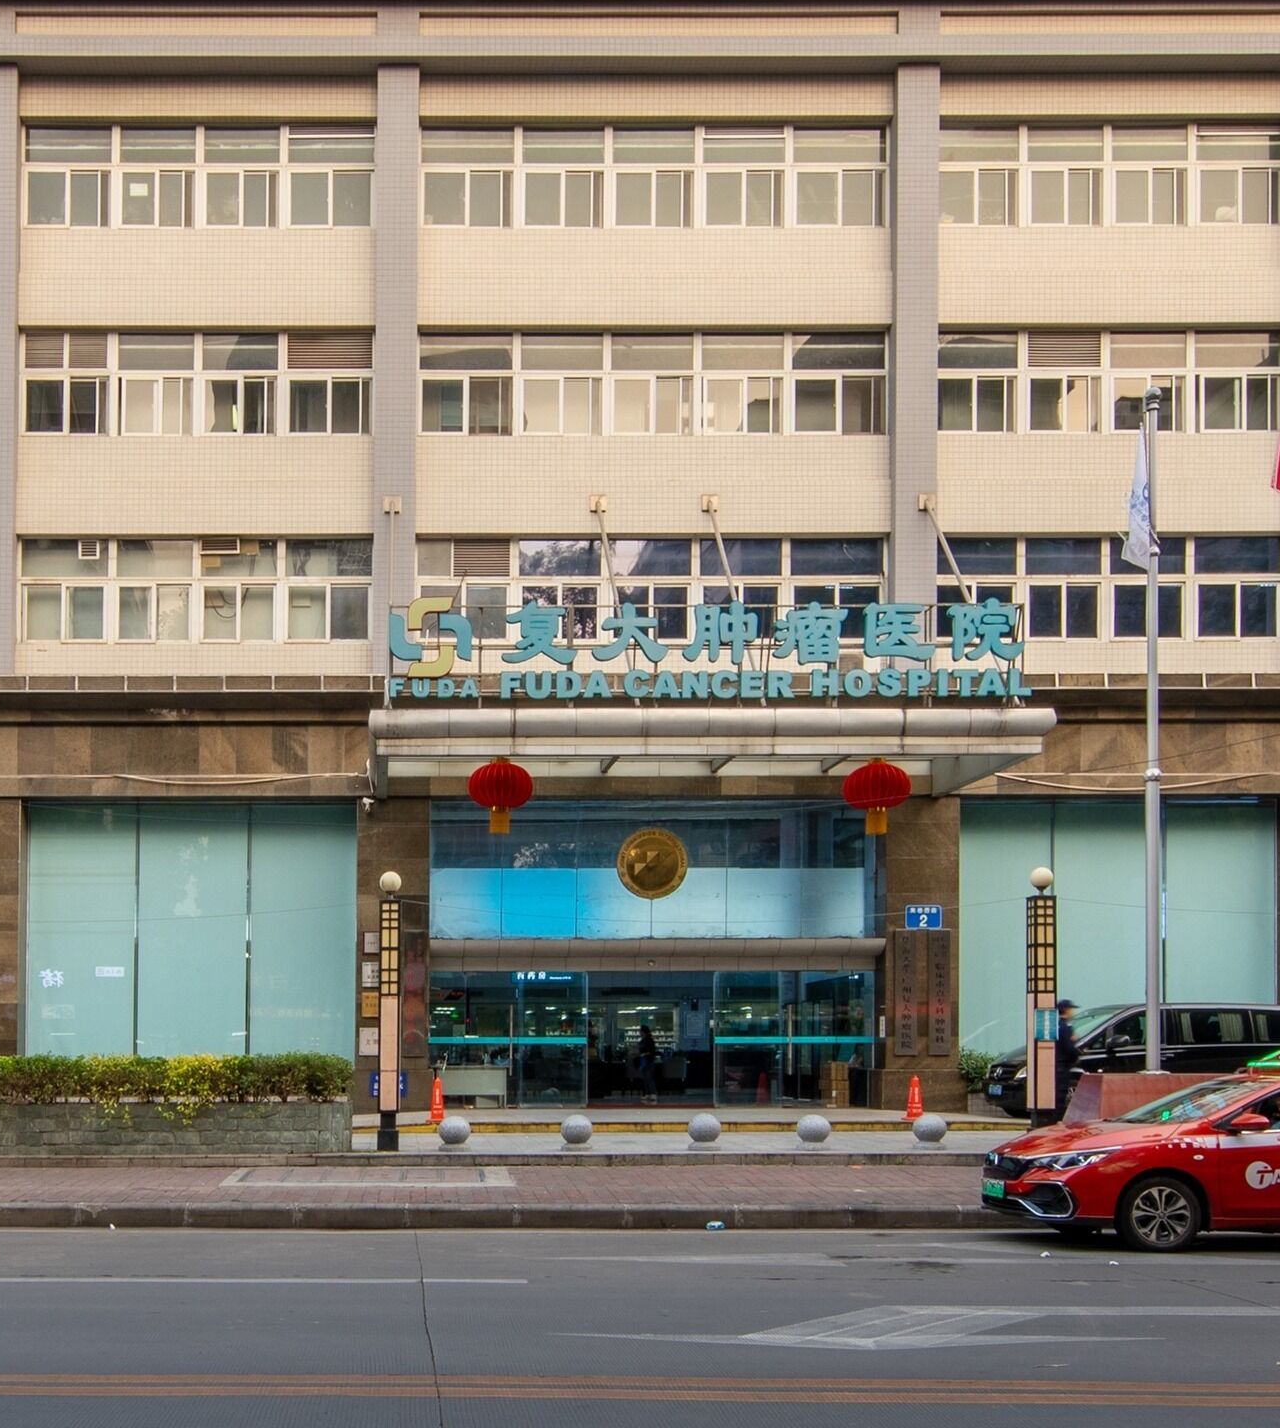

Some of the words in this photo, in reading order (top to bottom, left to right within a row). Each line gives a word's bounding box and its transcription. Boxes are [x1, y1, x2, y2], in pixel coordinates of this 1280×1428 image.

[502, 597, 1025, 664] 复大肿瘤医院
[389, 678, 479, 699] FUDA
[500, 670, 613, 700] FUDA
[625, 669, 795, 699] CANCER
[811, 668, 1032, 699] HOSPITAL
[919, 914, 928, 927] 2
